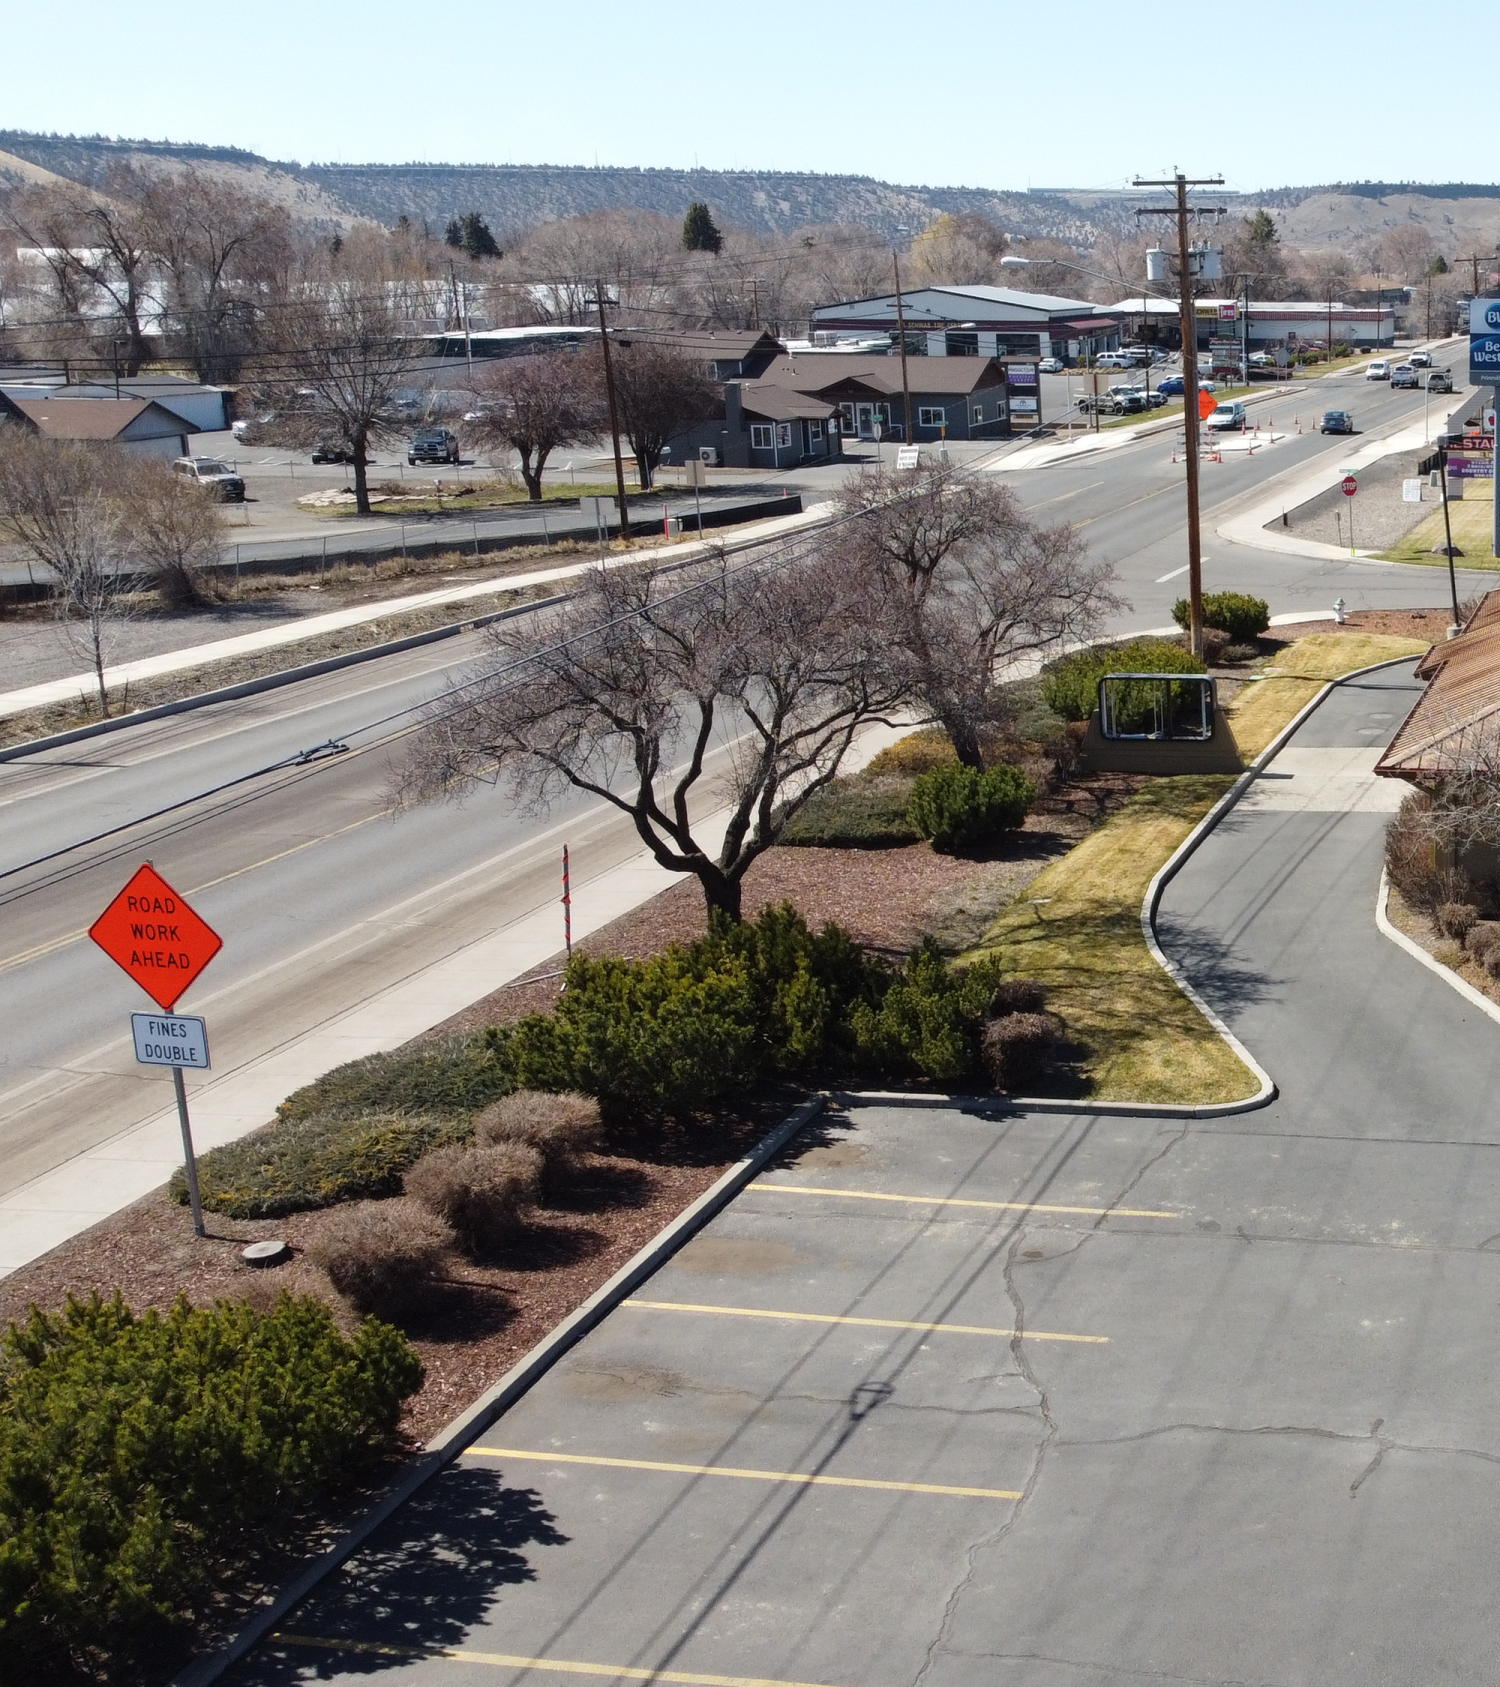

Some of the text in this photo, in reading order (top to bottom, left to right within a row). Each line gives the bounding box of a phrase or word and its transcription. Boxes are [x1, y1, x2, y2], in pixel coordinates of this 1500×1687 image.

[1342, 482, 1357, 491] STOP
[127, 896, 176, 914] ROAD
[131, 924, 182, 941] WORK
[130, 951, 191, 969] AHEAD
[149, 1021, 187, 1038] FINES
[145, 1044, 198, 1062] DOUBLE
